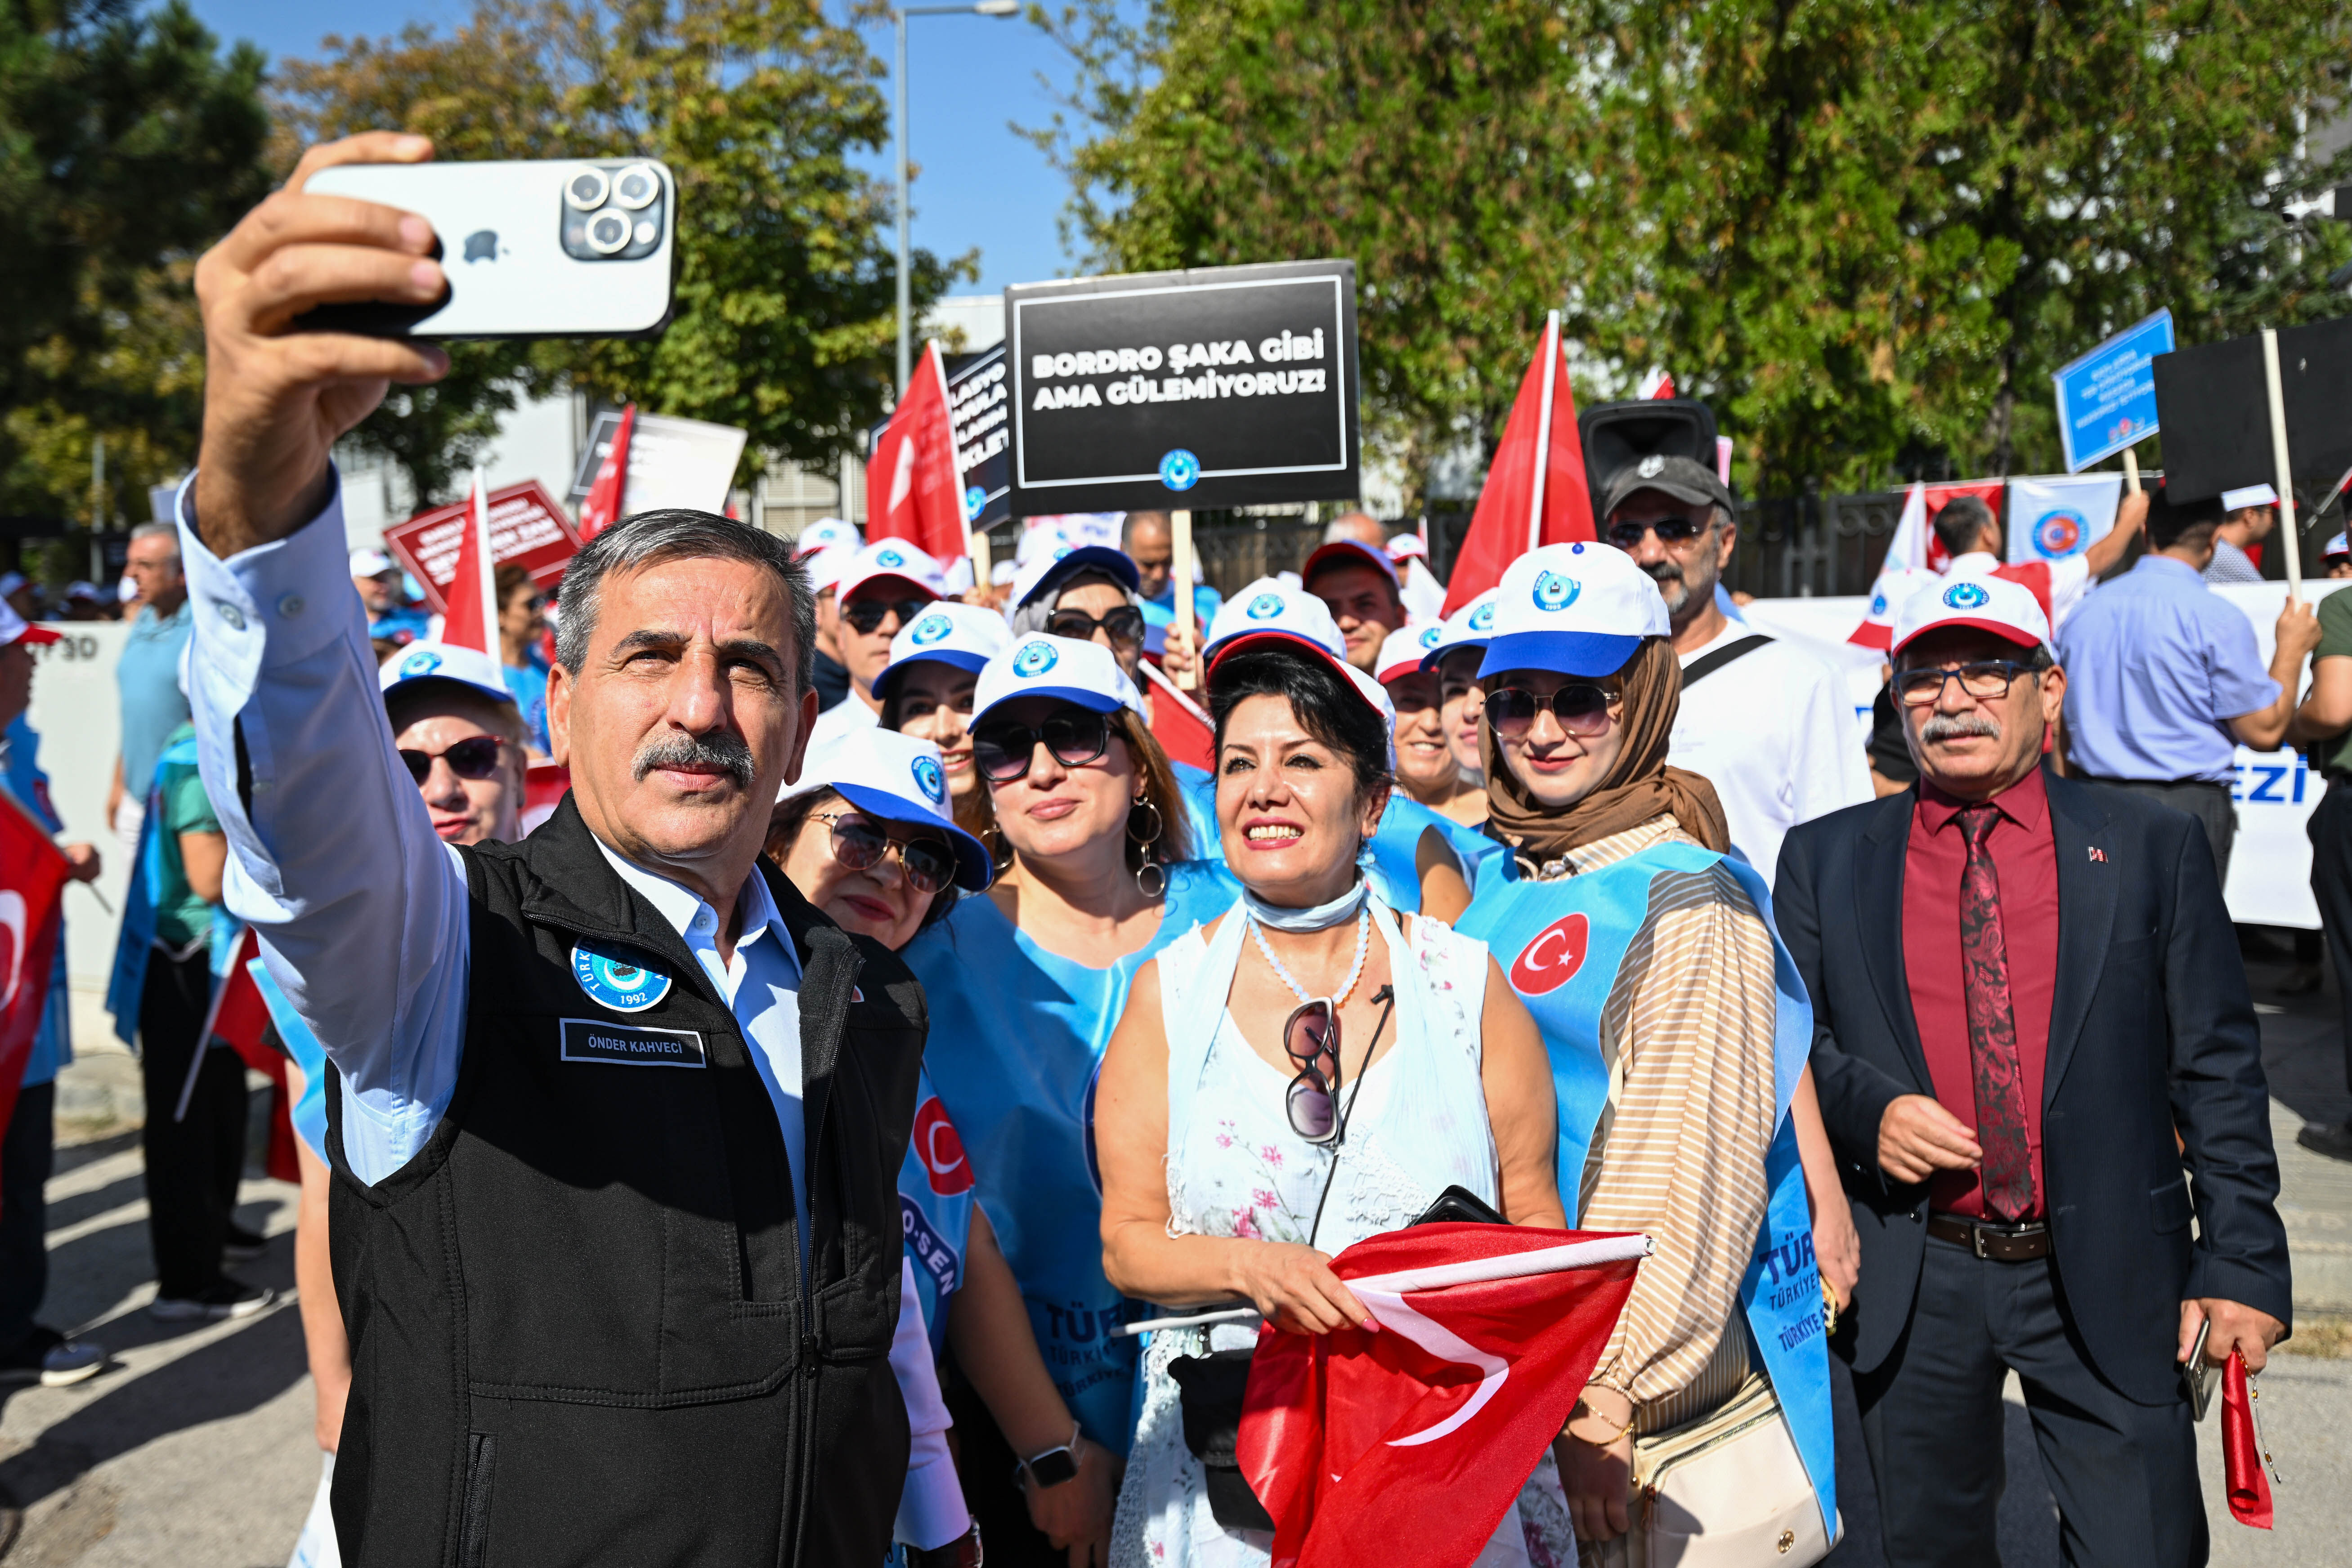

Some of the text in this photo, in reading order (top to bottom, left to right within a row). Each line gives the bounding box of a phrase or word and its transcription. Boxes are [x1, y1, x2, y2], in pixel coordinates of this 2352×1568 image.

[1032, 327, 1324, 379] BORDRO ŞAKA GİBİ
[1032, 368, 1326, 411] AMA GÜLEMİYORUZ!
[621, 992, 648, 1005] 1992
[588, 1033, 683, 1054] ÖNDER KAHVECİ
[1770, 1275, 1817, 1311] TÜRKİYE
[1778, 1312, 1822, 1353] TÜRKİYE
